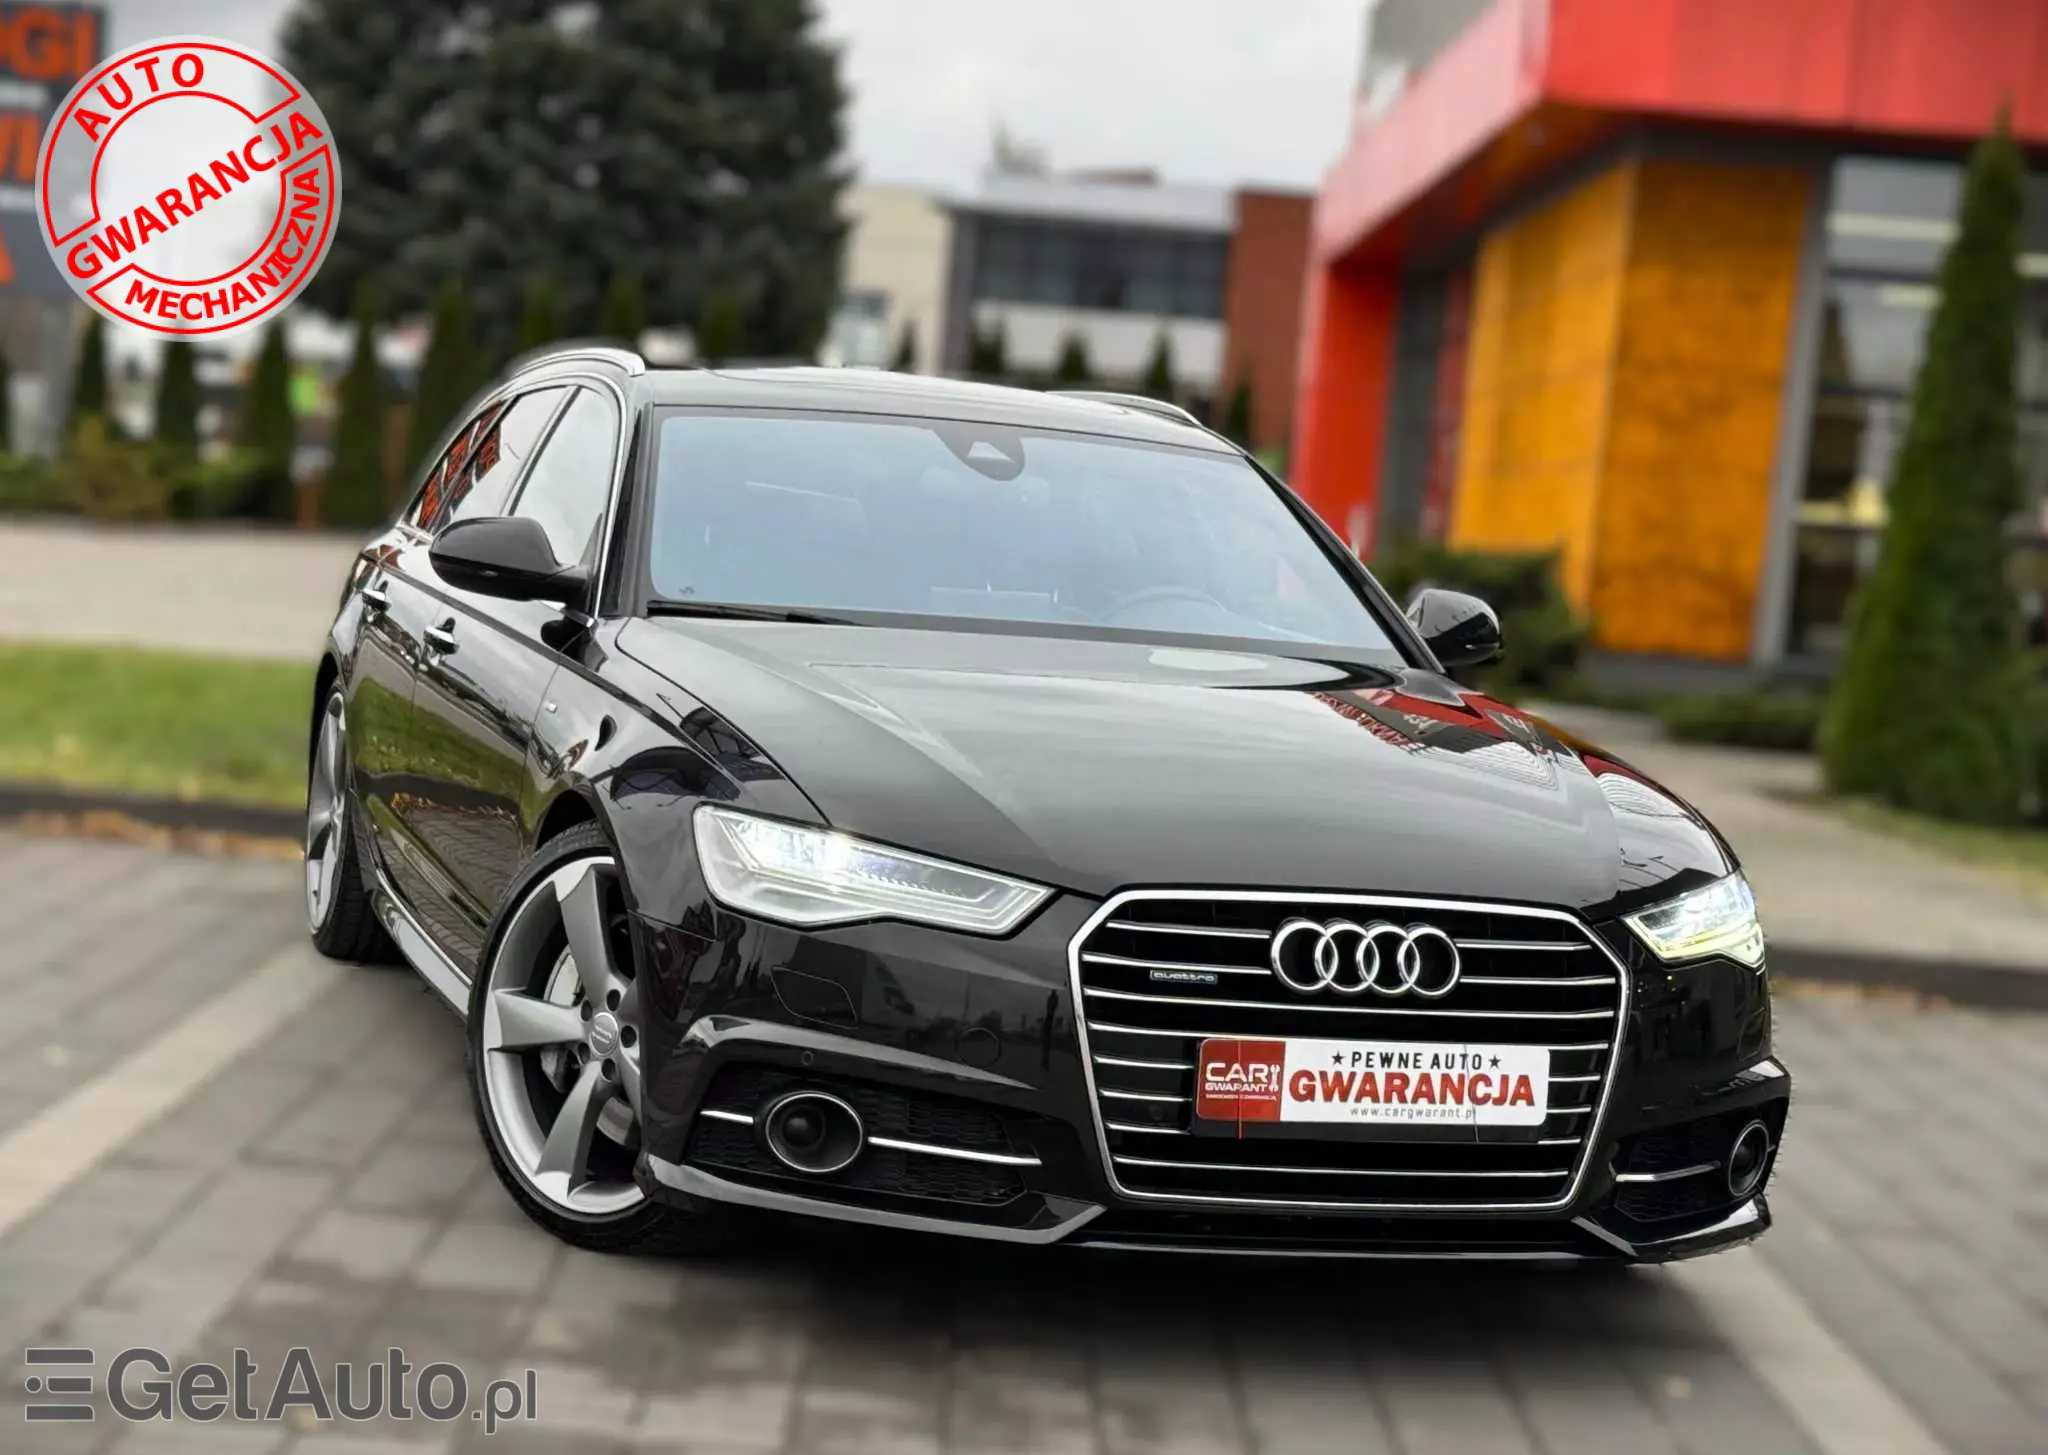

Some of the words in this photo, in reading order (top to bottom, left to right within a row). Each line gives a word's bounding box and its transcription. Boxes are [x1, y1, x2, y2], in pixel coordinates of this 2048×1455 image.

[1153, 970, 1215, 982] quattro
[1351, 1051, 1423, 1069] PEWNE
[1430, 1053, 1482, 1070] AUTO
[1206, 1062, 1268, 1083] CAR
[1204, 1082, 1268, 1092] GWARANT
[1289, 1070, 1535, 1107] GWARANCJA
[1350, 1107, 1476, 1120] www.cargwarant.pl
